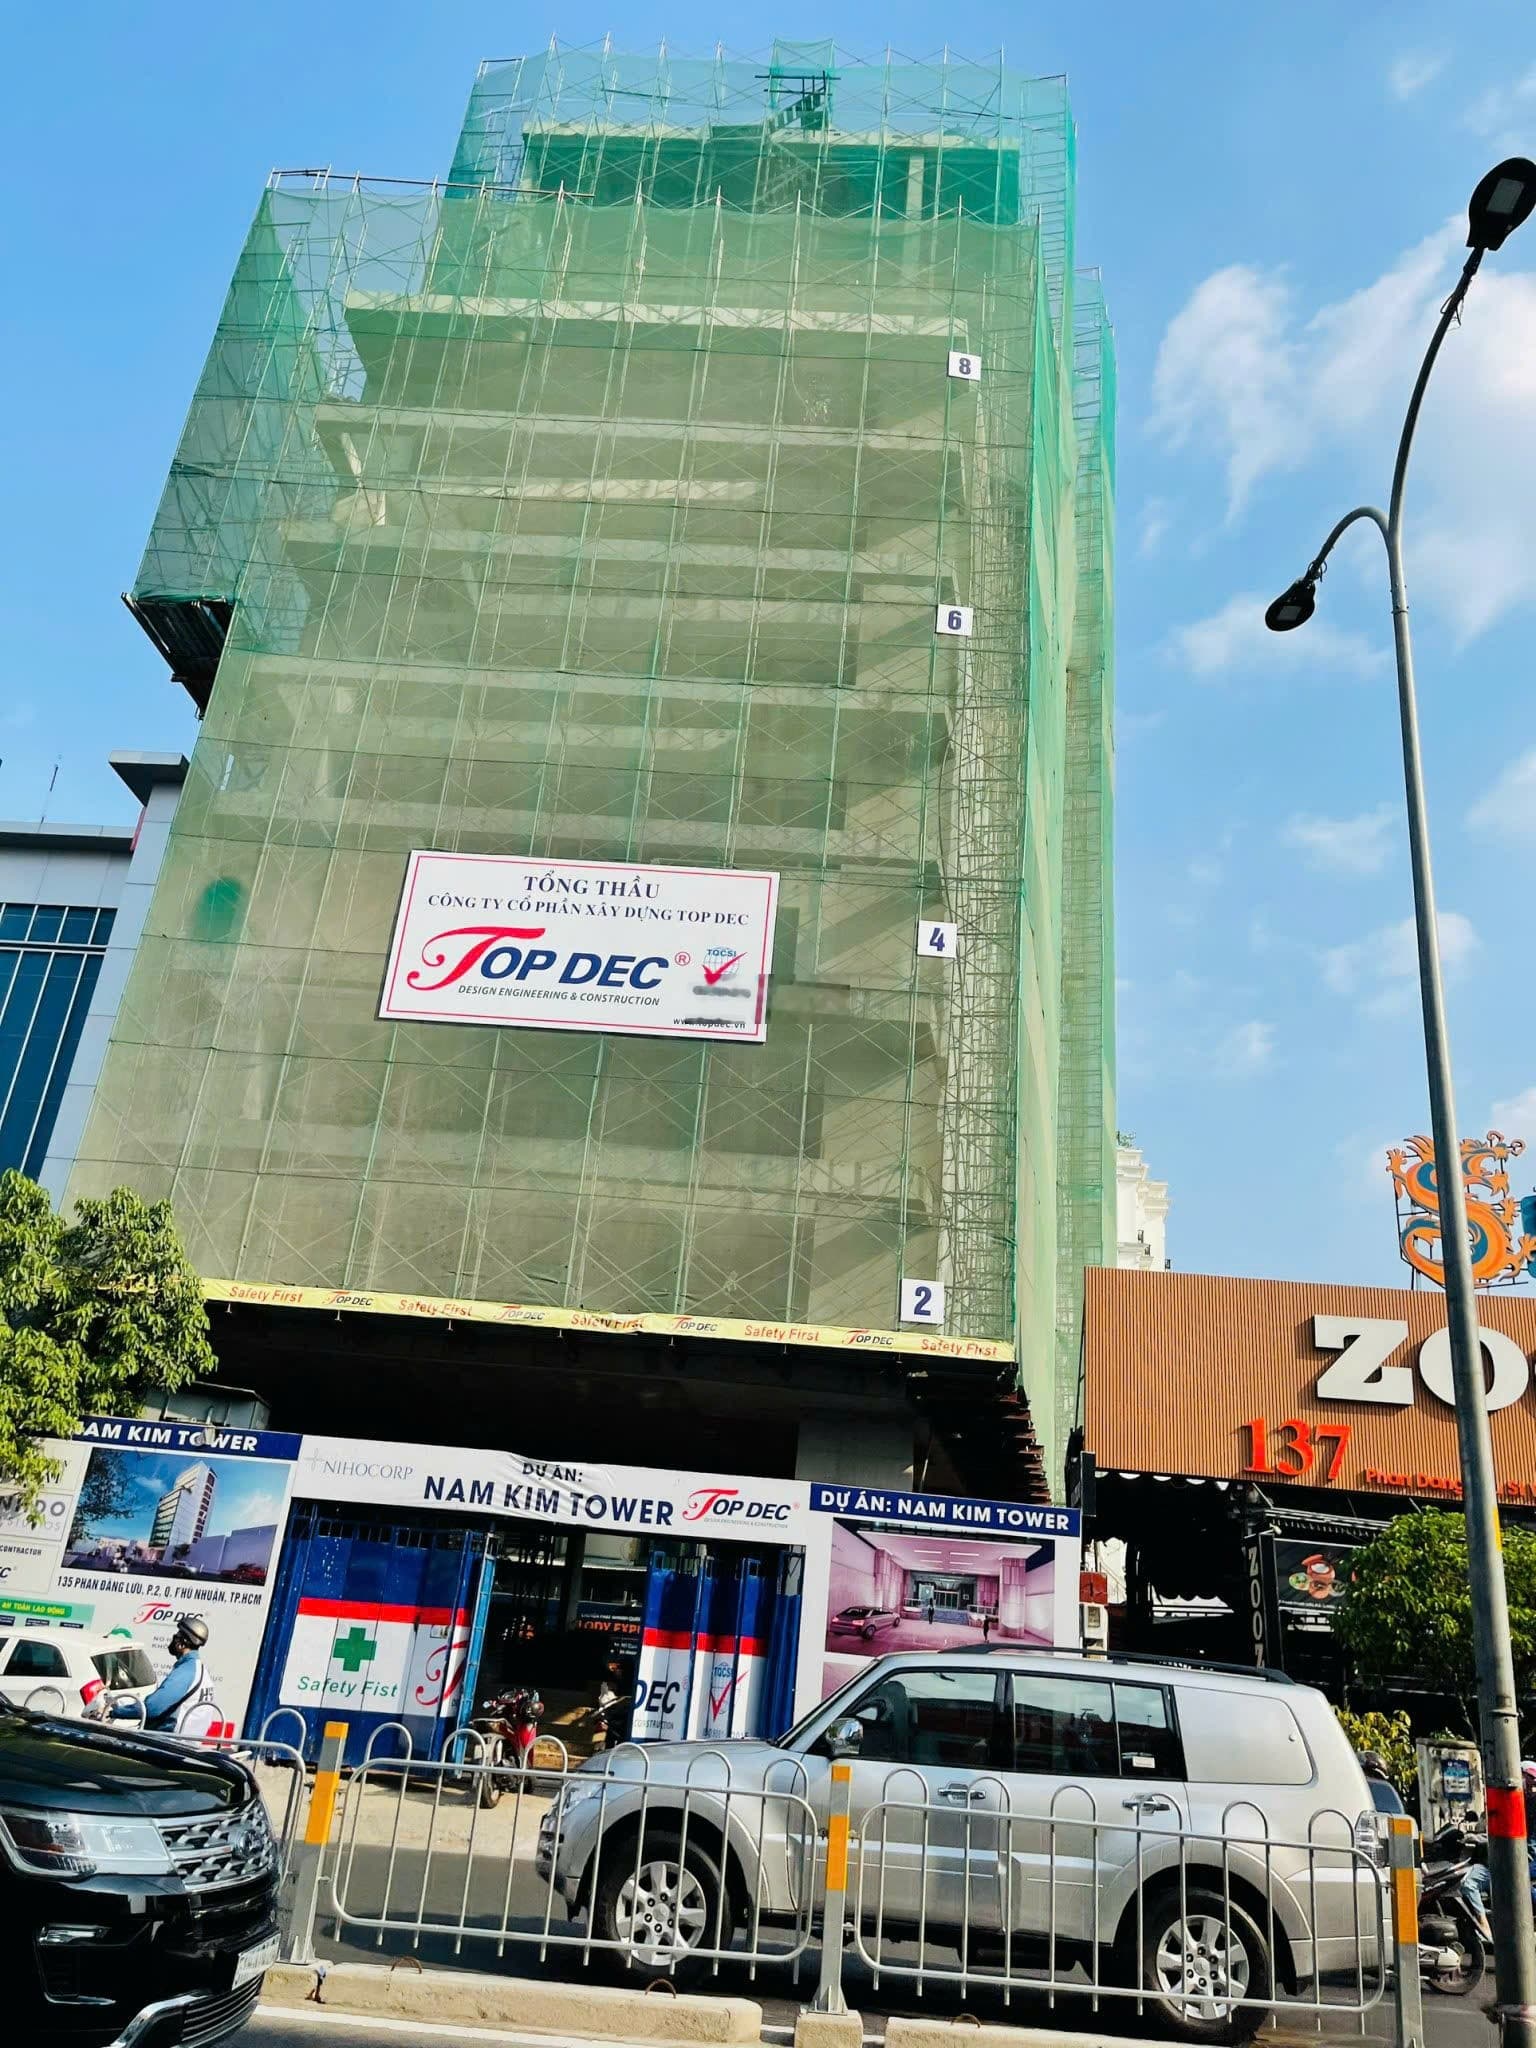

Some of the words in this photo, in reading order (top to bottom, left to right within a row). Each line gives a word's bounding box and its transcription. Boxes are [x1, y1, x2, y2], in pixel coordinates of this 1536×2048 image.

[958, 357, 972, 376] 8
[947, 610, 962, 631] 6
[524, 870, 588, 895] TỔNG
[596, 875, 661, 899] THẦU
[428, 892, 477, 909] CÔNG
[482, 897, 504, 910] TY
[585, 902, 622, 917] XÂY
[625, 905, 672, 922] DỰNG
[677, 909, 711, 924] TOP
[714, 912, 750, 926] DEC
[929, 927, 946, 952] 4
[407, 926, 557, 991] TOP
[558, 951, 669, 990] DEC
[458, 984, 497, 996] DESIGN
[498, 986, 568, 1001] ENGINEERING
[570, 992, 577, 1001] &
[579, 992, 660, 1007] CONSTRUCTION
[229, 1286, 269, 1301] Safety
[271, 1291, 304, 1303] First
[352, 1298, 374, 1306] DEC
[913, 1285, 932, 1317] 2
[695, 1322, 720, 1332] DEC
[744, 1325, 785, 1341] Safety
[788, 1328, 820, 1342] First
[842, 1329, 871, 1344] TOP
[872, 1336, 895, 1346] DEC
[921, 1338, 963, 1356] Safety
[1313, 1314, 1535, 1411] ZO
[81, 1422, 122, 1440] AM
[127, 1425, 172, 1445] KIM
[1241, 1416, 1352, 1481] 137
[323, 1460, 413, 1481] NIHOCORP
[1365, 1467, 1413, 1488] Phan
[1416, 1471, 1463, 1495] Dang
[424, 1476, 495, 1506] NAM
[504, 1484, 560, 1515] KIM
[570, 1492, 674, 1526] TOWER
[682, 1488, 745, 1521] TOP
[745, 1501, 792, 1521] DEC
[820, 1490, 851, 1512] DỰ
[854, 1490, 892, 1513] ÁN:
[897, 1498, 946, 1519] NAM
[952, 1503, 992, 1523] KIM
[996, 1508, 1070, 1531] TOWER
[57, 1575, 74, 1588] 135
[74, 1577, 98, 1590] PHAN
[230, 1591, 262, 1606] TP.HCM
[133, 1602, 174, 1624] TOP
[297, 1675, 357, 1697] Safety
[361, 1681, 399, 1698] Fist
